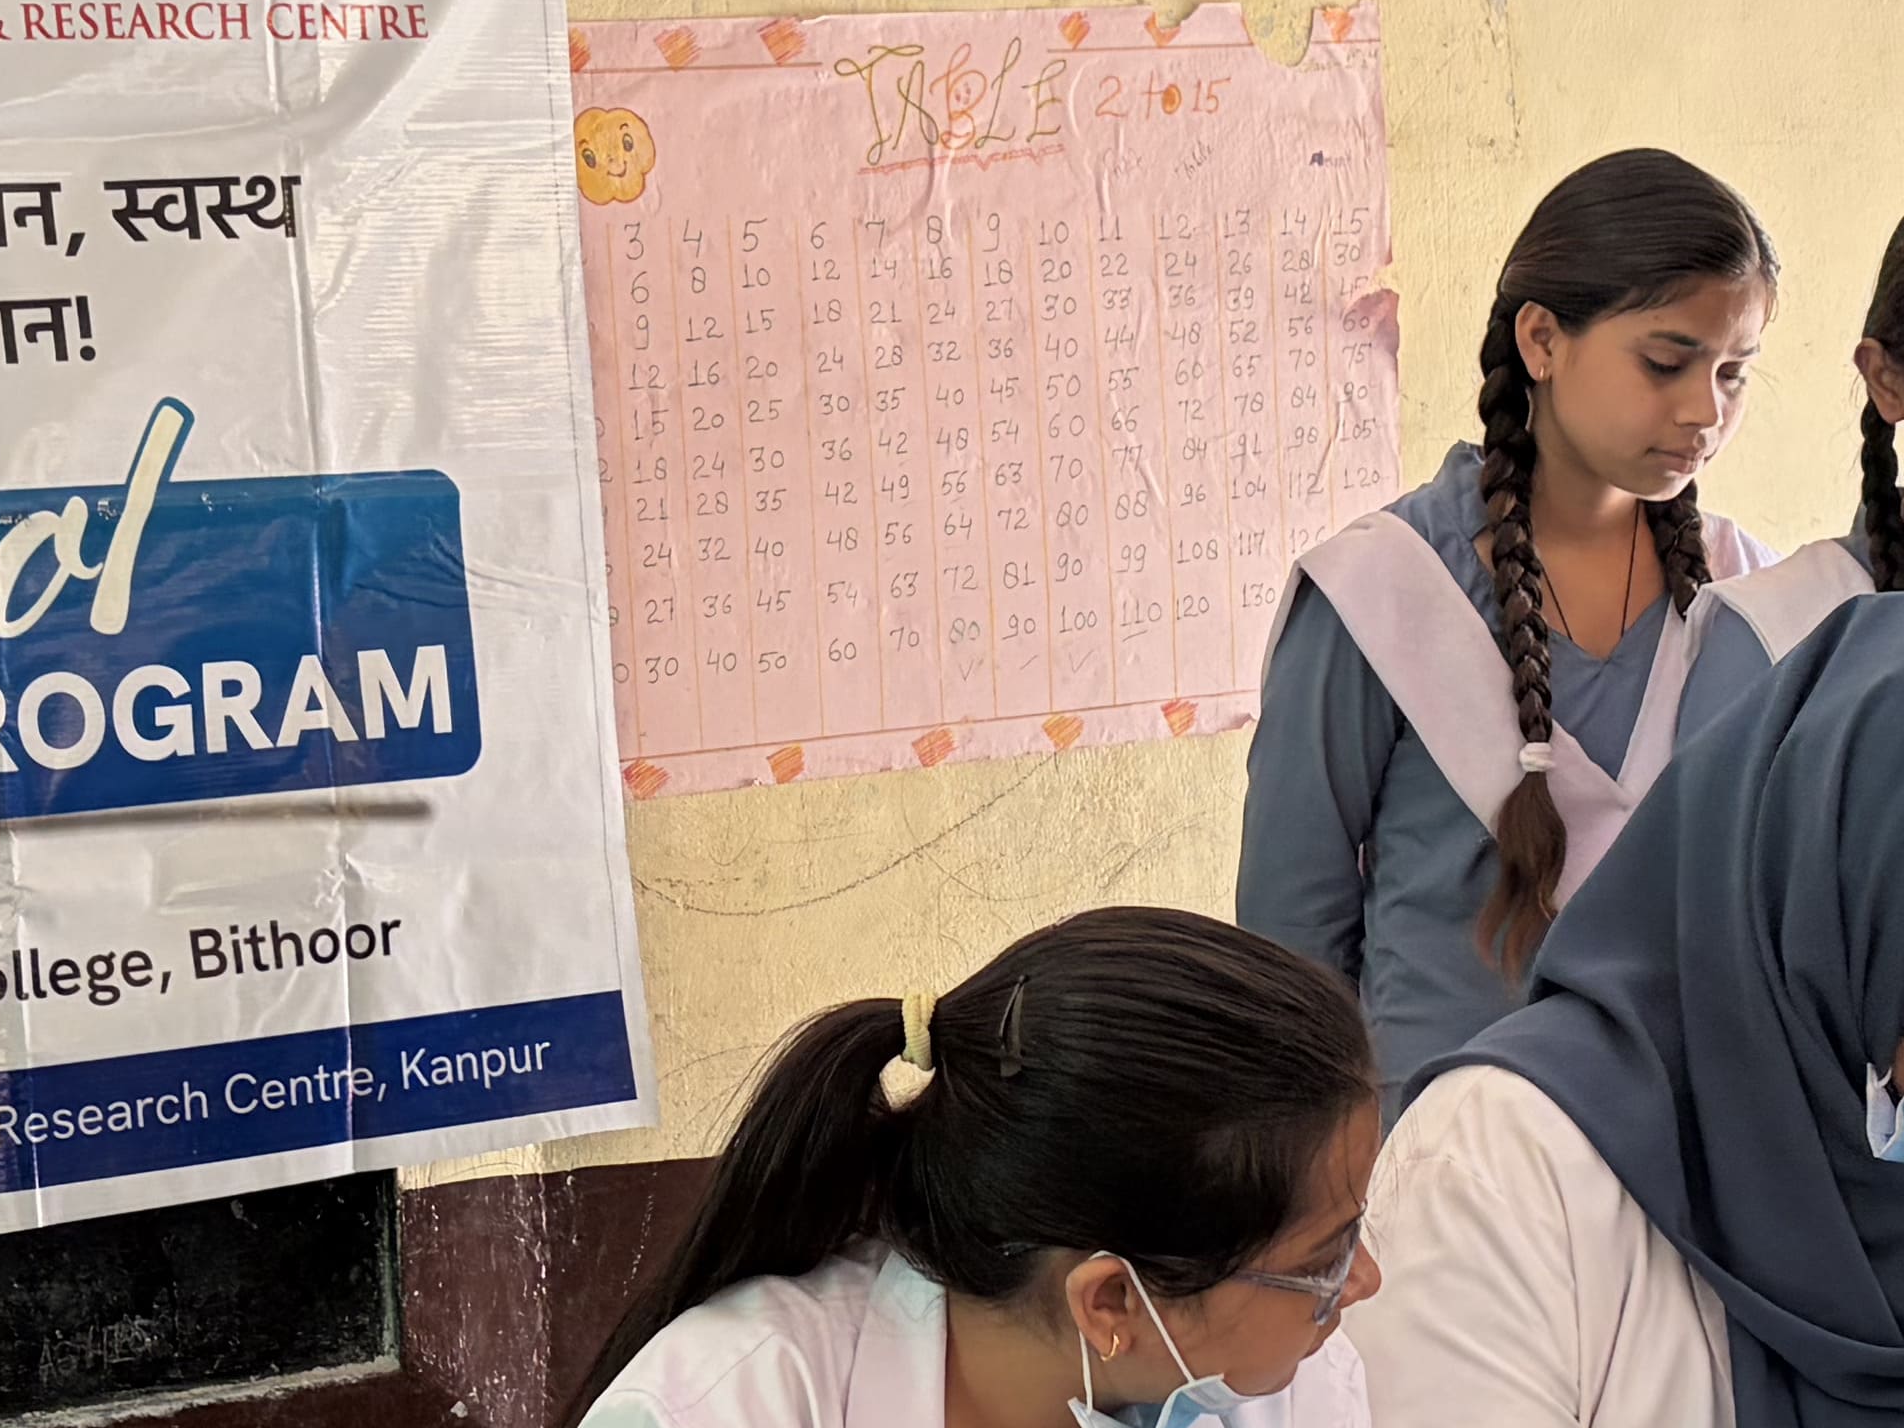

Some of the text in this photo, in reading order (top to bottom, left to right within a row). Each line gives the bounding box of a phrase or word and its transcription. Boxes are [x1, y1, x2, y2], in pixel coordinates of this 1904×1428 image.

[23, 2, 253, 41] RESEARCH
[267, 3, 429, 40] CENTRE
[835, 37, 1068, 166] TABLE
[1095, 76, 1127, 118] 2
[1193, 77, 1232, 115] 15
[105, 173, 301, 243] स्वस्थ
[623, 220, 645, 261] 3
[682, 218, 703, 259] 4
[741, 217, 769, 253] 5
[809, 220, 828, 251] 6
[864, 219, 887, 250] 7
[981, 212, 1001, 253] 9
[1038, 220, 1070, 247] 10
[1099, 216, 1123, 242] 11
[1157, 213, 1193, 241] 12
[1223, 207, 1251, 240] 13
[1280, 206, 1307, 237] 14
[1335, 206, 1370, 235] 15
[629, 270, 650, 305] 6
[741, 262, 772, 289] 10
[811, 258, 841, 282] 12
[869, 256, 898, 280] 14
[927, 254, 953, 280] 16
[634, 313, 650, 351] 9
[684, 316, 725, 343] 12
[744, 308, 776, 335] 15
[868, 299, 903, 325] 21
[627, 362, 667, 391] 12
[687, 359, 721, 389] 16
[745, 355, 779, 381] 20
[816, 345, 844, 374] 24
[633, 386, 907, 442] 15 20 25 30 35
[692, 451, 726, 481] 24
[748, 445, 785, 473] 30
[821, 436, 853, 462] 36
[877, 427, 909, 456] 42
[636, 497, 670, 523] 21
[754, 487, 788, 513] 35
[823, 480, 858, 507] 42
[880, 473, 910, 503] 49
[642, 541, 673, 570] 24
[697, 536, 732, 562] 32
[753, 536, 785, 563] 40
[884, 521, 913, 546] 56
[644, 571, 919, 625] 27 36 45 54 63
[644, 655, 680, 685] 30
[706, 647, 738, 675] 40
[757, 651, 787, 674] 50
[827, 637, 857, 663] 60
[889, 625, 920, 653] 70
[1001, 613, 1037, 641] 90
[1058, 604, 1098, 634] 100
[1119, 598, 1163, 628] 110
[1174, 596, 1210, 623] 120
[1241, 582, 1276, 609] 130
[189, 917, 401, 981] Bithoor
[224, 1062, 389, 1115] Centre,
[401, 1037, 551, 1092] Kanpur
